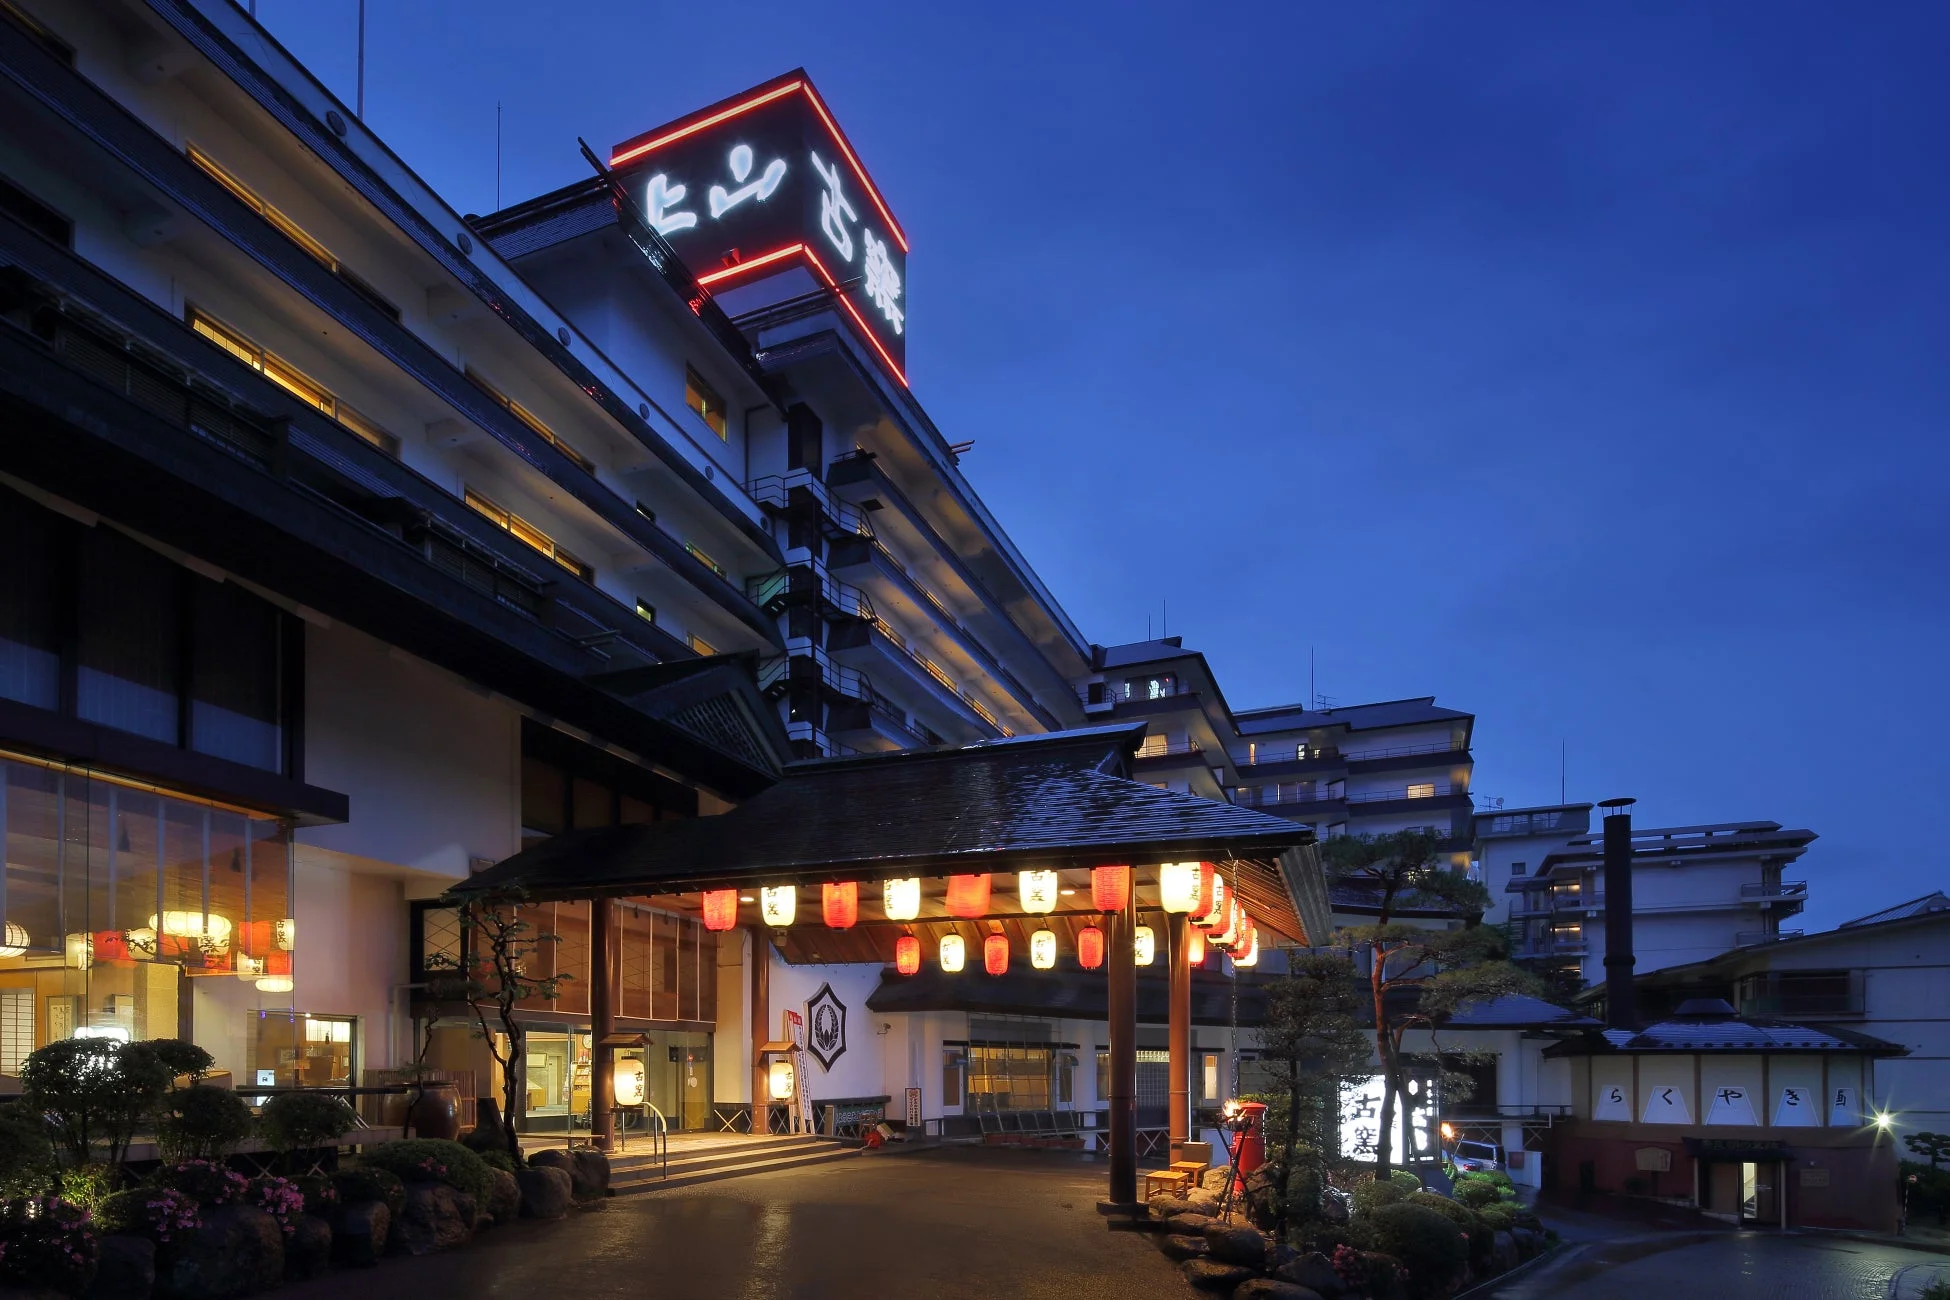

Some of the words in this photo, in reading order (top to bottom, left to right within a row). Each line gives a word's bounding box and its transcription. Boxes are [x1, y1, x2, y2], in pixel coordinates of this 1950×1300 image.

[811, 151, 905, 335] 古窯
[634, 1070, 644, 1098] 古窯
[785, 1071, 793, 1093] 古窯
[1353, 1093, 1381, 1155] 古窯
